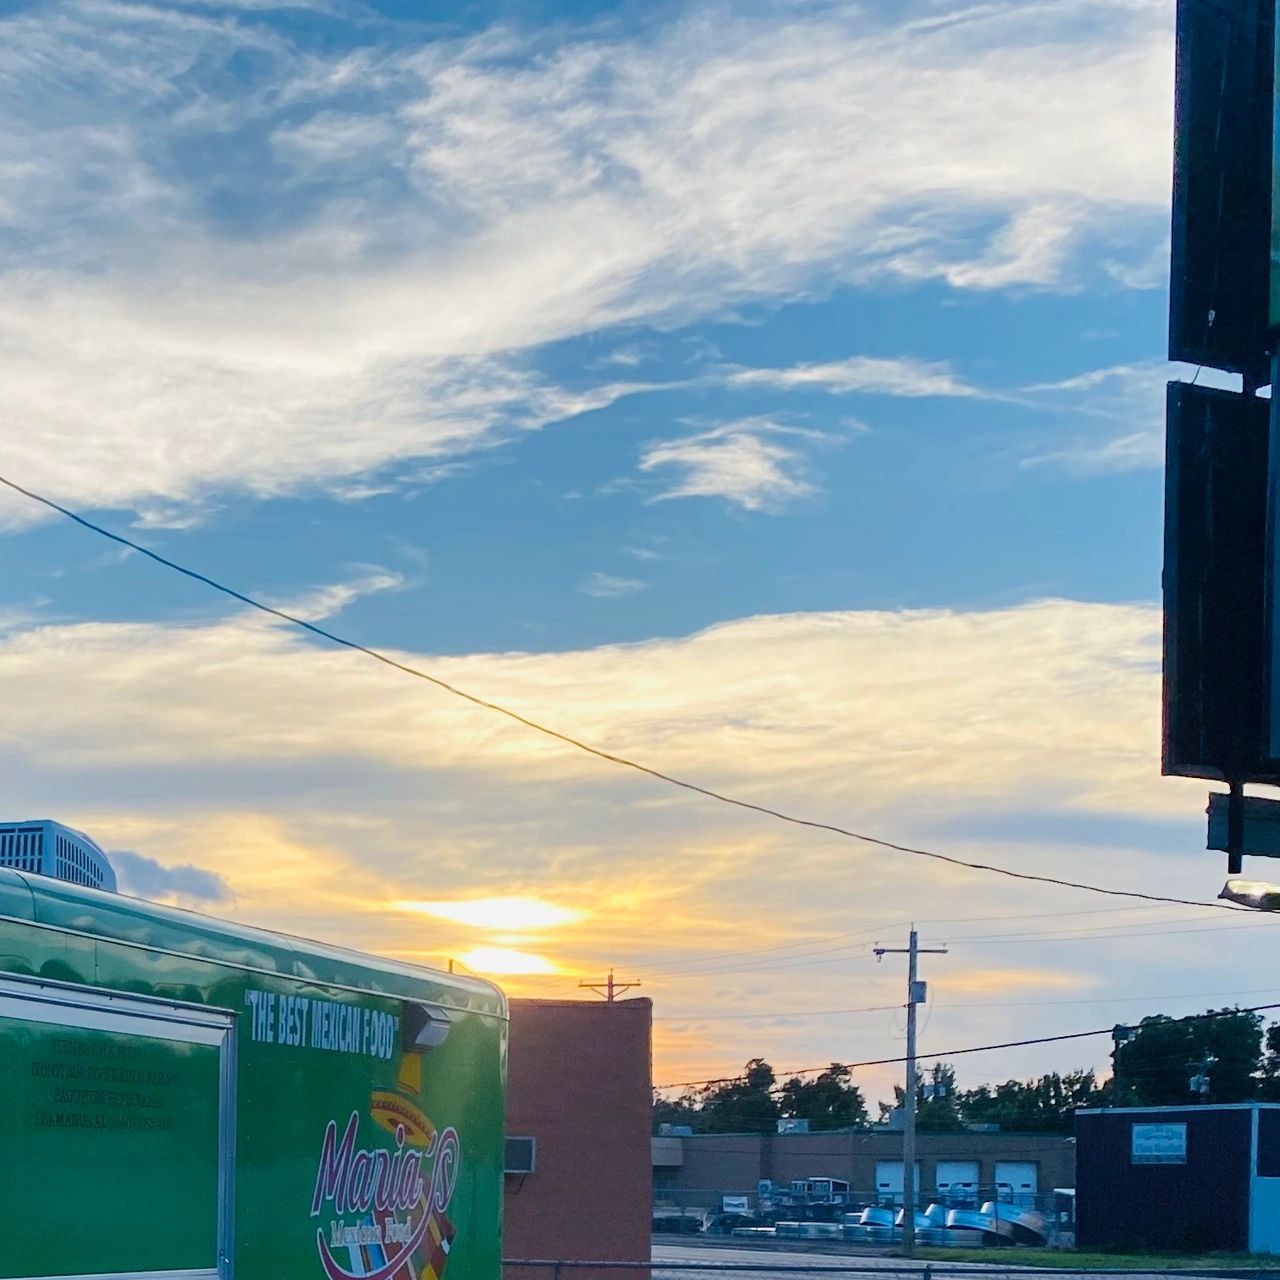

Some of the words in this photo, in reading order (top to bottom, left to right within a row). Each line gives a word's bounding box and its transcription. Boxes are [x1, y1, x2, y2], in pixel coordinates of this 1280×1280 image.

[278, 994, 308, 1047] BEST
[311, 1000, 360, 1054] MEXICAN
[330, 1219, 382, 1247] Mexican
